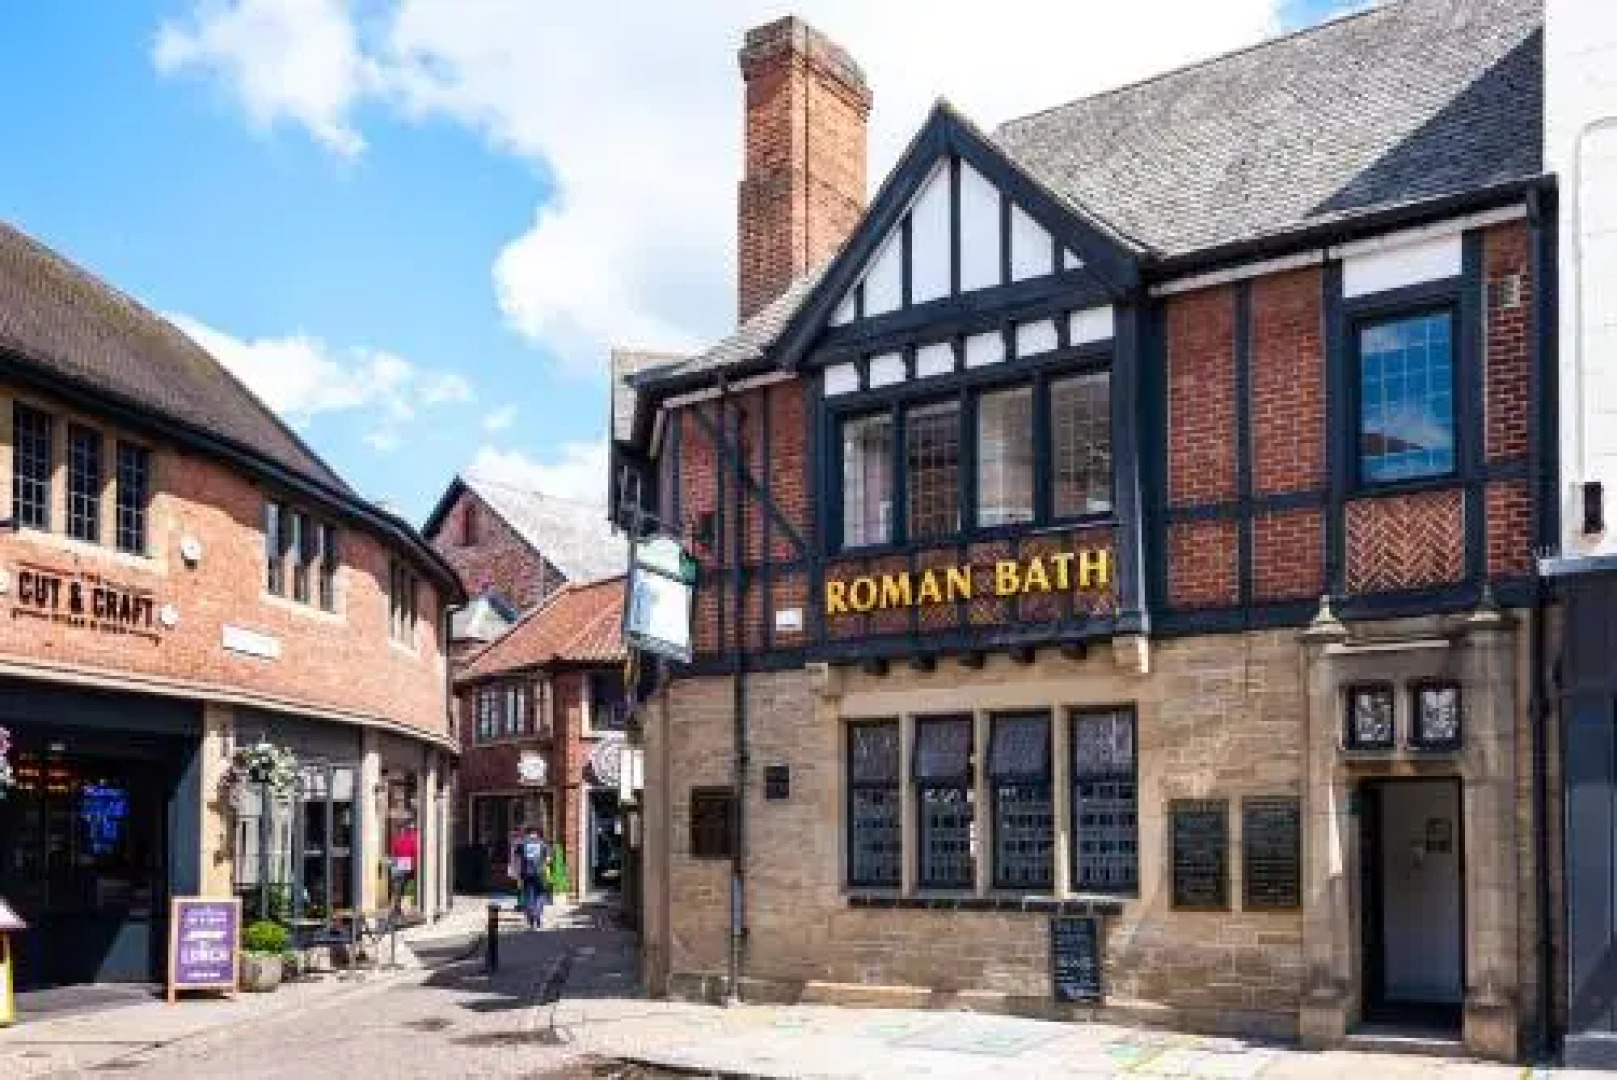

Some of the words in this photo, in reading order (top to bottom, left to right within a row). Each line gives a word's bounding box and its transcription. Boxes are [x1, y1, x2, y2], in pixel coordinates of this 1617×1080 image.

[19, 572, 61, 608] CUT
[70, 582, 83, 613] &
[92, 588, 154, 627] CRAFT
[826, 565, 971, 614] ROMAN
[994, 549, 1110, 597] BATH
